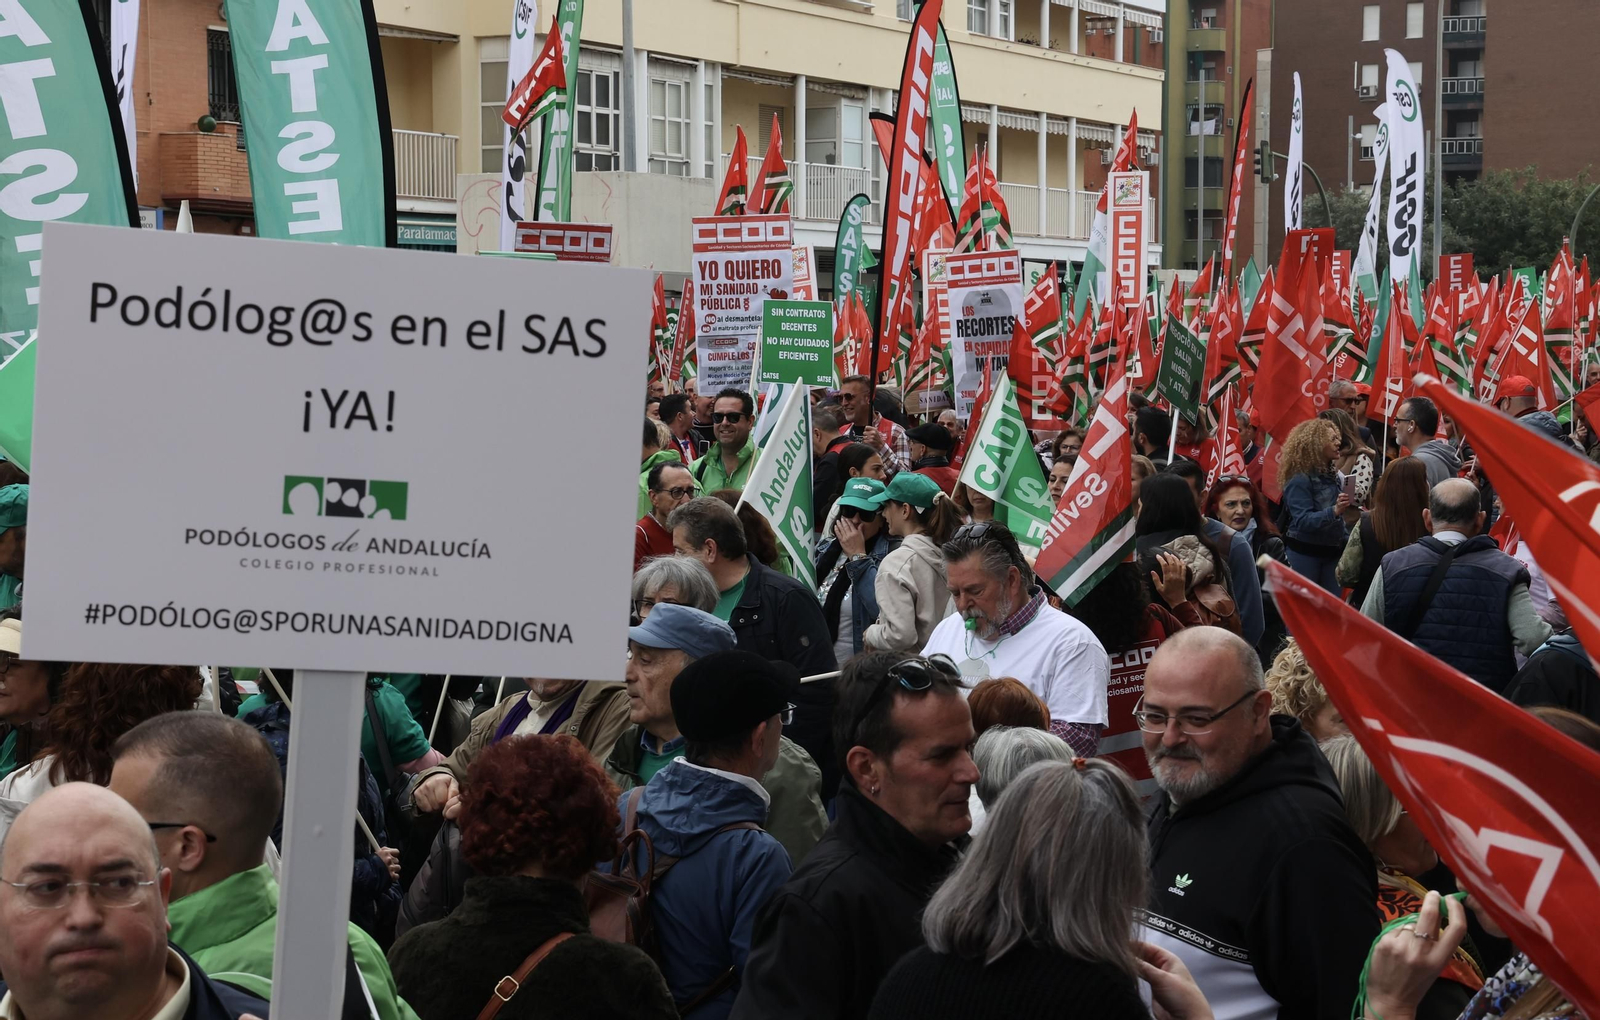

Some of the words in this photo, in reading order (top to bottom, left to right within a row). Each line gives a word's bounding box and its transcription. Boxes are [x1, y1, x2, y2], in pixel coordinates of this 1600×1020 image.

[397, 226, 456, 241] Parafarmac
[693, 220, 791, 243] CCOO
[515, 228, 612, 253] CCOO
[698, 260, 719, 281] YO
[724, 258, 782, 282] QUIERO
[946, 255, 1020, 280] CCOO
[700, 284, 713, 296] MI
[716, 282, 759, 296] SANIDAD
[701, 296, 741, 311] PÚBLICA
[962, 305, 975, 316] LOS
[90, 281, 374, 348] Podólog@s
[390, 314, 448, 348] en
[465, 308, 506, 352] el
[521, 313, 608, 359] SAS
[717, 315, 723, 323] al
[771, 308, 784, 317] SIN
[785, 308, 826, 319] CONTRATOS
[740, 323, 762, 332] profesi
[781, 322, 817, 332] DECENTES
[956, 315, 1015, 338] RECORTES
[766, 336, 778, 345] NO
[779, 337, 793, 346] HAY
[793, 338, 830, 348] CUIDADOS
[964, 341, 973, 352] EN
[1169, 321, 1191, 348] NEGOCIO
[1190, 343, 1197, 356] EN
[1196, 349, 1203, 362] LA
[708, 352, 736, 362] CUMPLE
[738, 350, 750, 360] LOS
[778, 351, 819, 362] EFICIENTES
[975, 356, 1008, 372] MTAN
[762, 372, 779, 380] SATSE
[817, 375, 832, 383] SATSE
[1168, 376, 1173, 386] Y
[302, 387, 396, 433] ¡YA!
[760, 407, 810, 516] Andaluc
[185, 526, 326, 551] PODÓLOGOS
[331, 528, 360, 552] de
[365, 536, 492, 559] ANDALUCÍA
[239, 557, 315, 571] COLEGIO
[322, 561, 440, 577] PROFESIONAL
[84, 600, 574, 645] #PODÓLOG@SPORUNASANIDADDIGNA
[1108, 645, 1157, 670] COO
[1122, 676, 1128, 685] y
[1130, 673, 1145, 682] sec
[1108, 684, 1145, 697] ciosanita
[1168, 886, 1185, 897] adidas
[1148, 916, 1166, 928] adidas
[1178, 928, 1205, 945] adidas
[1218, 946, 1248, 960] adidas
